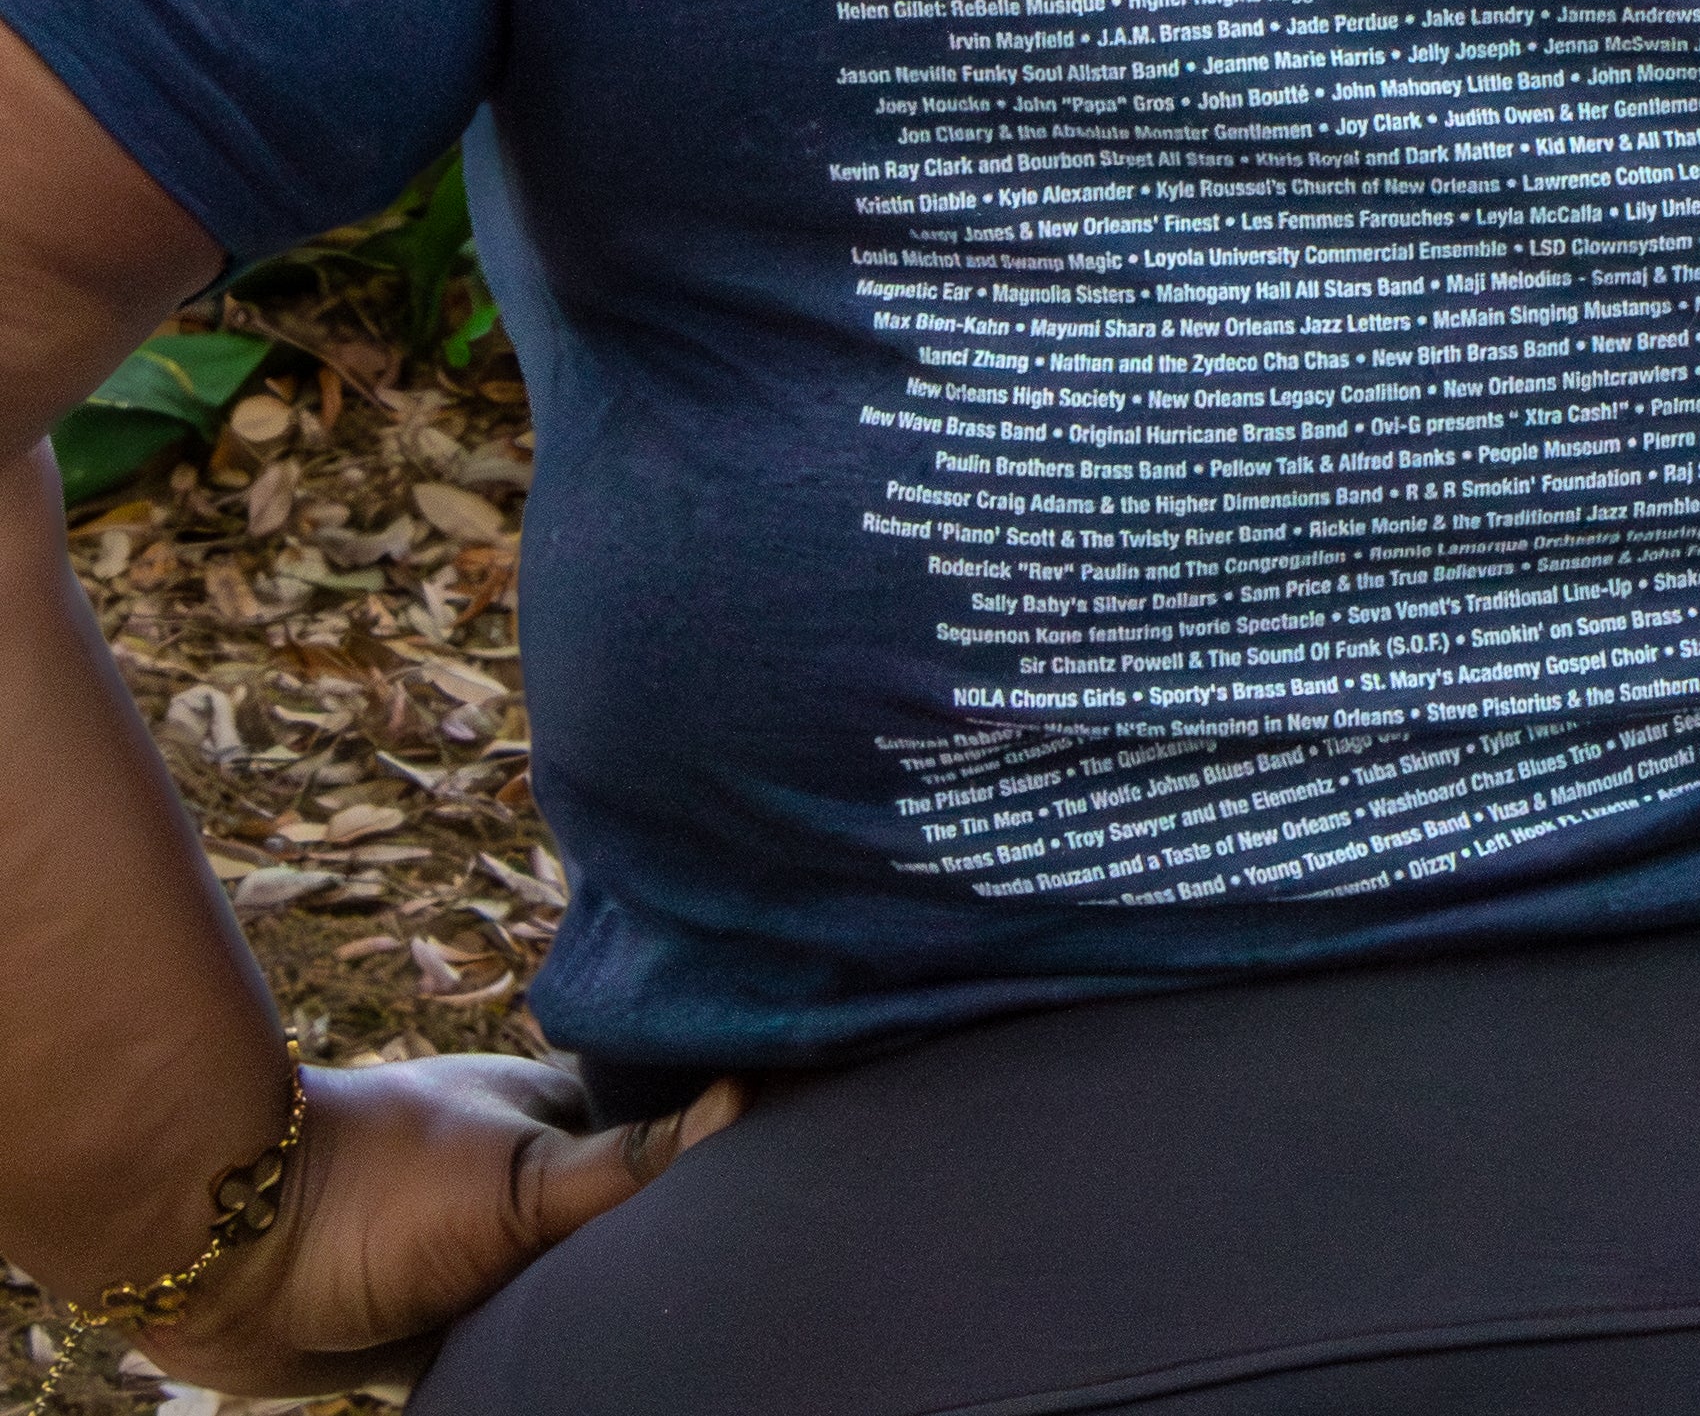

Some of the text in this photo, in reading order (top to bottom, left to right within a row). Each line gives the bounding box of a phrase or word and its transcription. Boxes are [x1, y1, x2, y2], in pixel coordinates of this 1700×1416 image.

[996, 13, 1398, 52] Mayfield Perdue
[1203, 39, 1521, 74] Jeanne Joseph
[1248, 78, 1462, 107] Boutté Mahoney
[1335, 117, 1368, 137] Joy
[1373, 112, 1422, 132] Clark
[1018, 142, 1514, 171] Bourbon Matter
[1043, 182, 1134, 203] Alexander
[1084, 211, 1354, 235] Orleans' Femmes
[1209, 247, 1300, 267] University
[1305, 243, 1414, 264] Commercial
[993, 284, 1071, 306] Magnolia
[1156, 284, 1251, 305] Mahogany
[1031, 319, 1100, 340] Mayumi
[1347, 314, 1411, 332] Letters
[973, 350, 1029, 373] Zhang
[1418, 345, 1461, 365] Birth
[1059, 388, 1125, 412] Society
[1270, 388, 1335, 409] Legacy
[1070, 412, 1504, 447] Original presents
[996, 443, 1538, 478] Brothers People
[887, 480, 971, 507] Professor
[1224, 491, 1330, 511] Dimensions
[862, 512, 1055, 547] Richard Scott
[928, 556, 1011, 579] Roderick
[972, 593, 1018, 615] Sally
[1465, 585, 1558, 612] Traditional
[1247, 644, 1305, 665] Sound
[1387, 633, 1449, 658] (S.O.F.)
[953, 662, 1540, 708] NOLA Chorus Mary's Academy
[1482, 693, 1562, 717] Pistorius
[1620, 678, 1700, 701] Southern
[935, 771, 1061, 809] Pfister Sisters
[961, 818, 989, 835] Tin
[1109, 814, 1176, 841] Sawyer
[1161, 811, 1351, 866] Taste Orleans
[1244, 842, 1368, 885] Young Tuxedo
[1408, 852, 1456, 879] Dizzy
